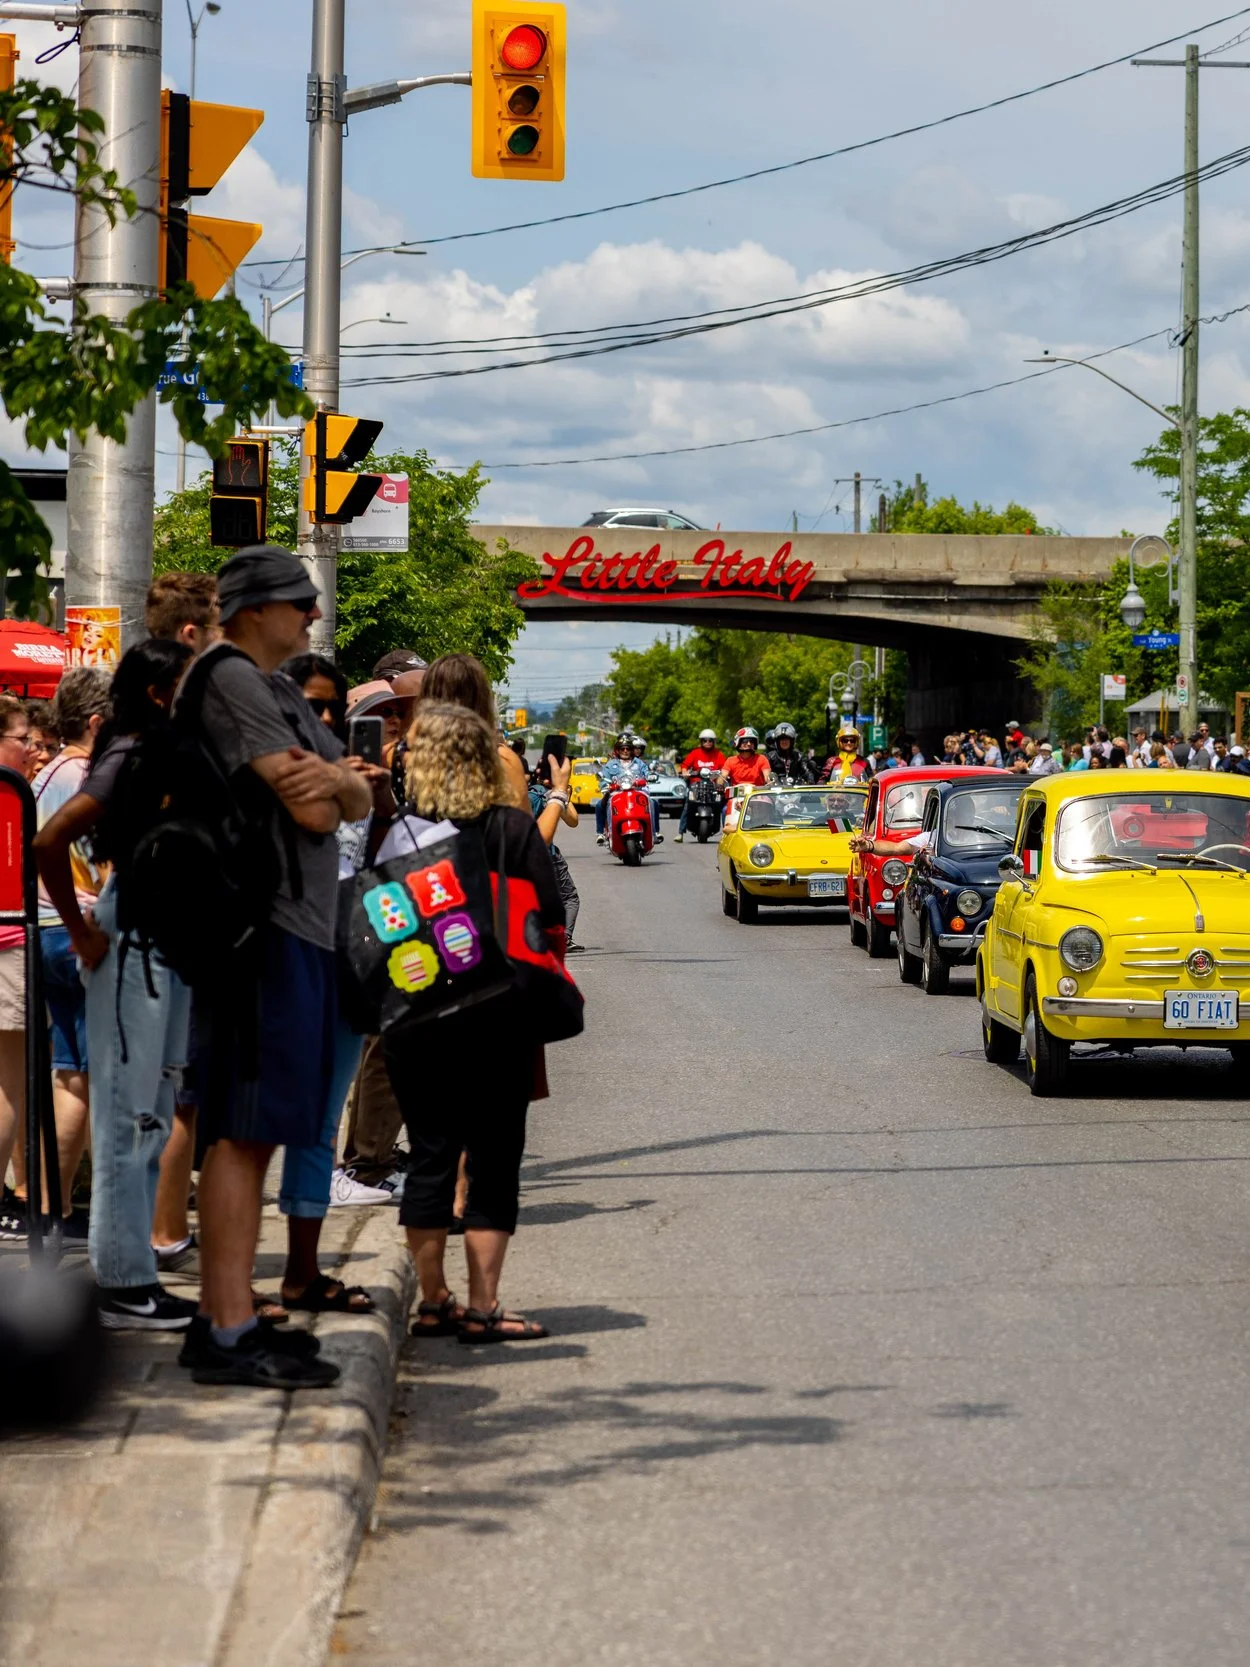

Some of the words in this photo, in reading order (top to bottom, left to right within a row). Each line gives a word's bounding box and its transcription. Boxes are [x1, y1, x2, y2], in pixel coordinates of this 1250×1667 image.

[159, 374, 177, 385] rue
[516, 535, 680, 602] Little
[692, 538, 817, 602] Italy
[872, 727, 884, 741] P
[1172, 1000, 1190, 1019] 60
[1198, 1000, 1232, 1019] FIAT
